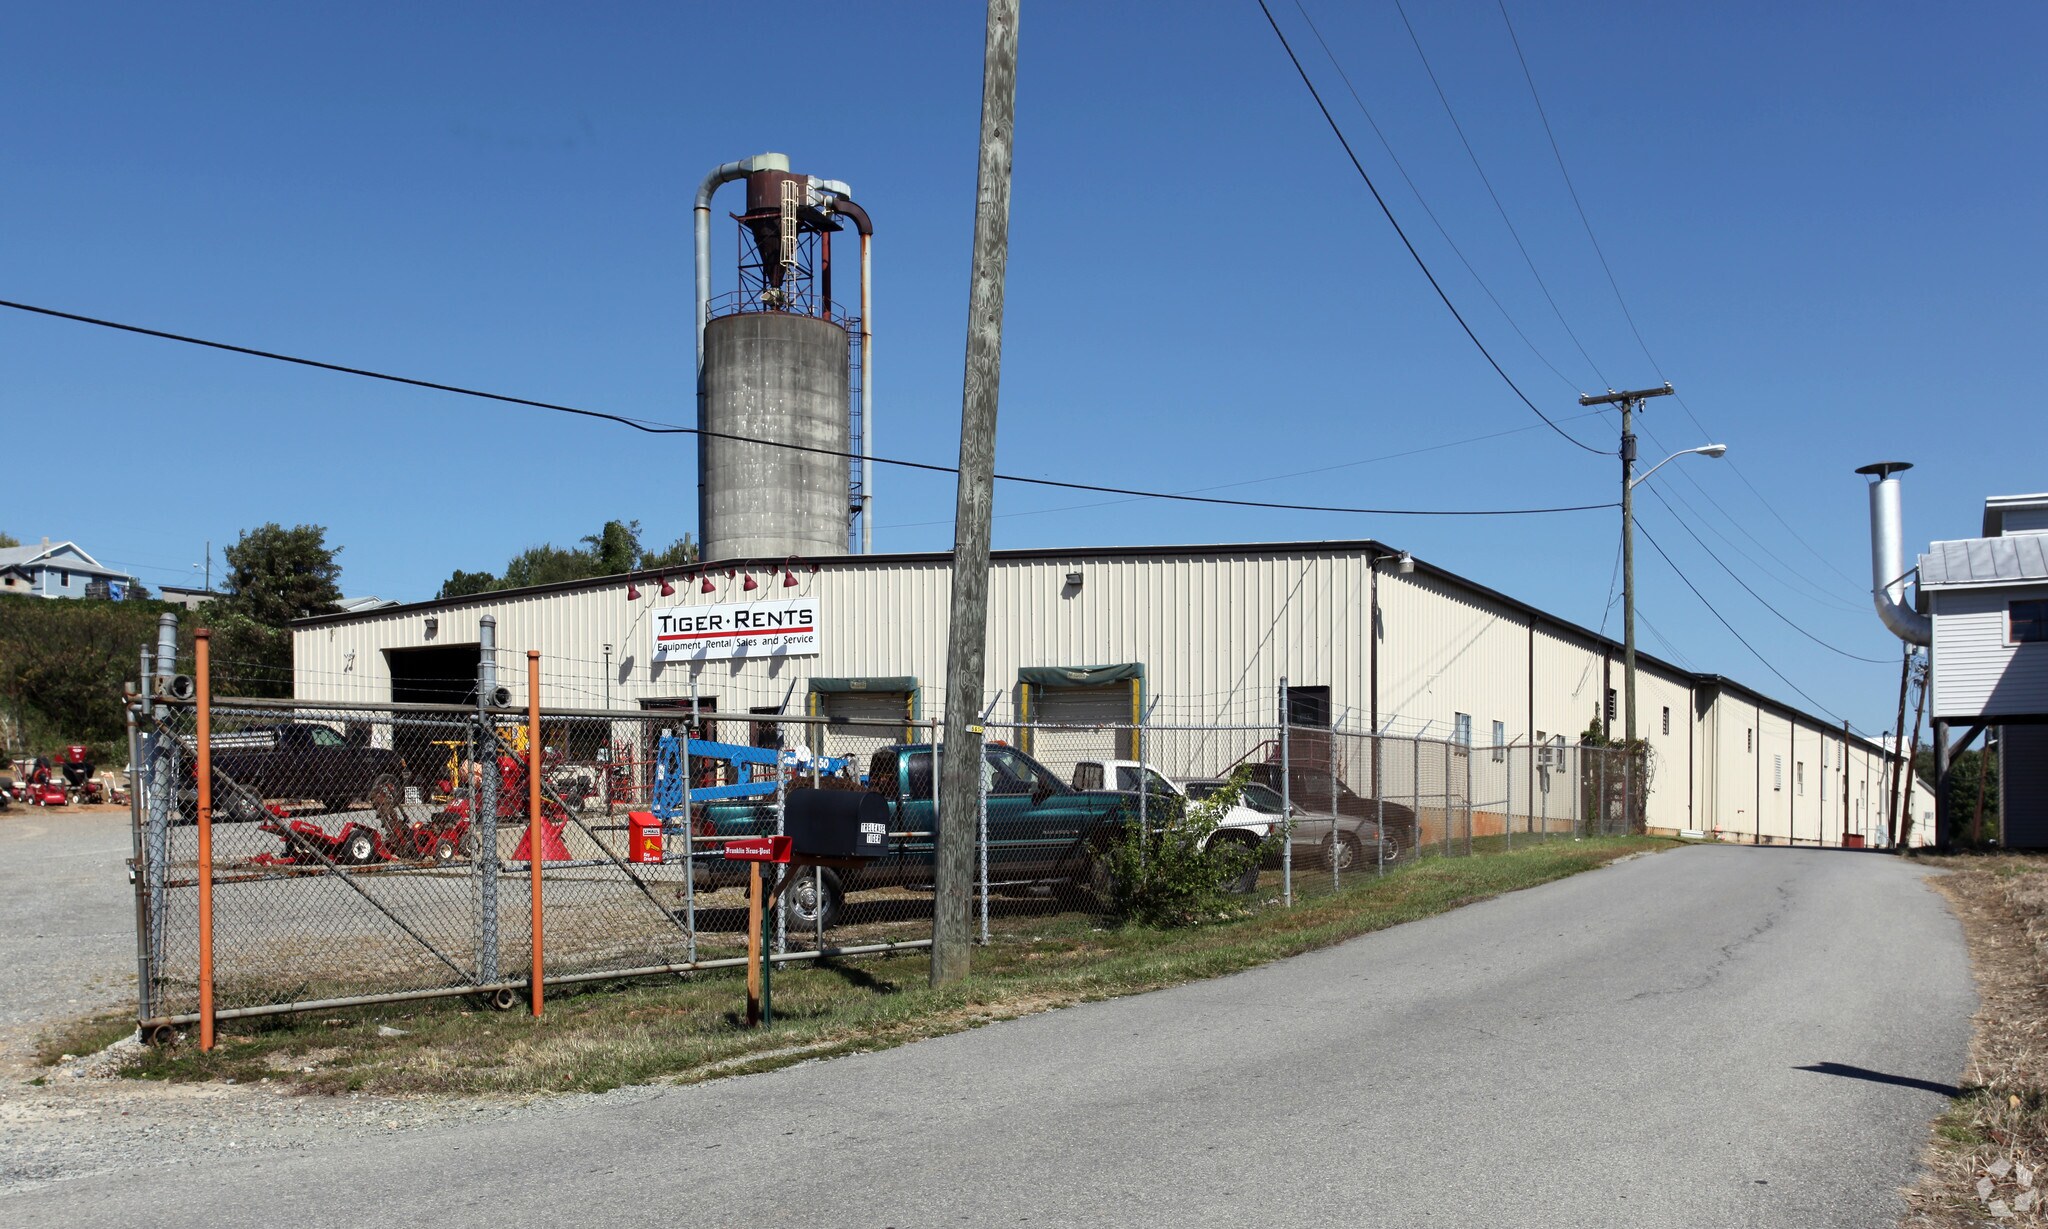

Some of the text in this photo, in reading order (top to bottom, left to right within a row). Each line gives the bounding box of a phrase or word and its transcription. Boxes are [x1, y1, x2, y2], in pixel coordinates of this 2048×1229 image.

[657, 635, 813, 653] Equipment Rental Sales and Service
[867, 833, 881, 843] TIGER
[726, 846, 745, 854] Franklin
